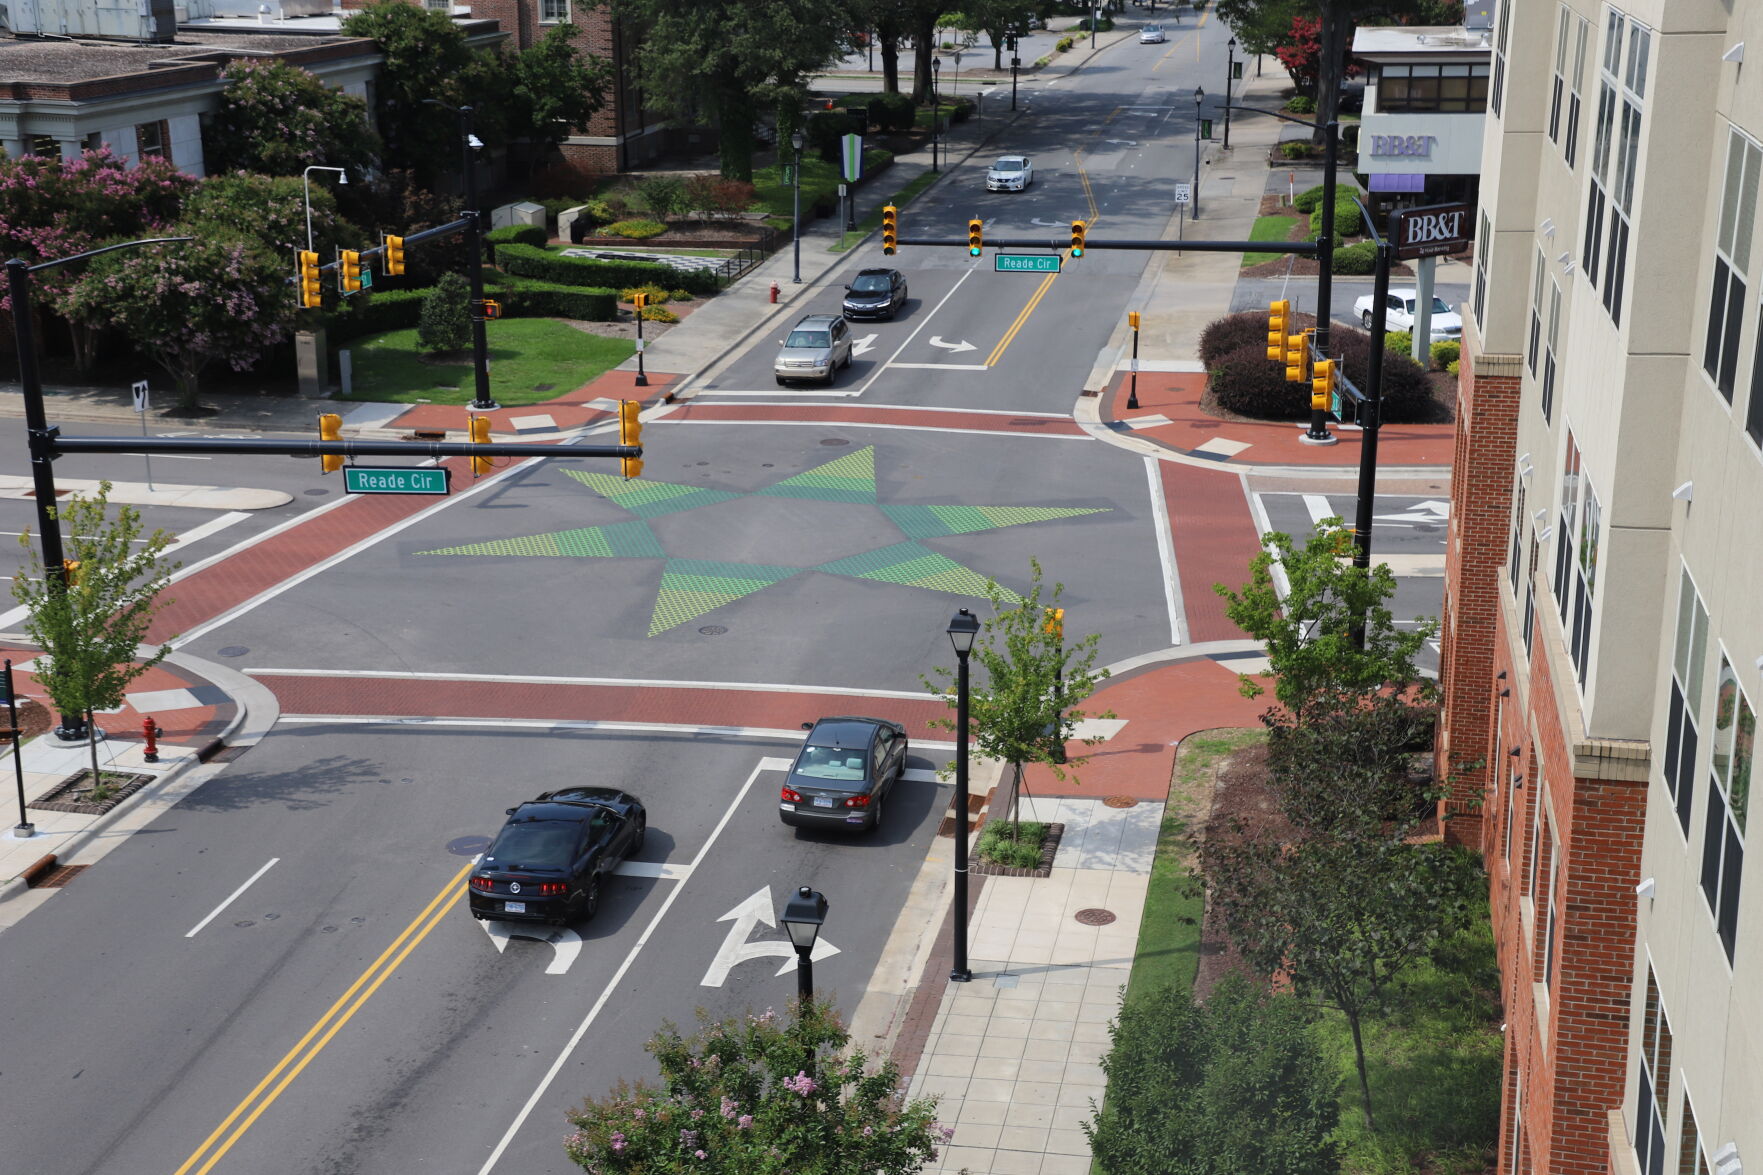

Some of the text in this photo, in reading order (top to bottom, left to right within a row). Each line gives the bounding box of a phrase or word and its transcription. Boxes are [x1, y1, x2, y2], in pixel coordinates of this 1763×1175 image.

[1370, 135, 1438, 158] BB&T
[1176, 193, 1189, 201] 25
[1407, 211, 1465, 243] BB&T
[1004, 257, 1052, 269] Reade Cir
[358, 472, 433, 489] Reade Cir
